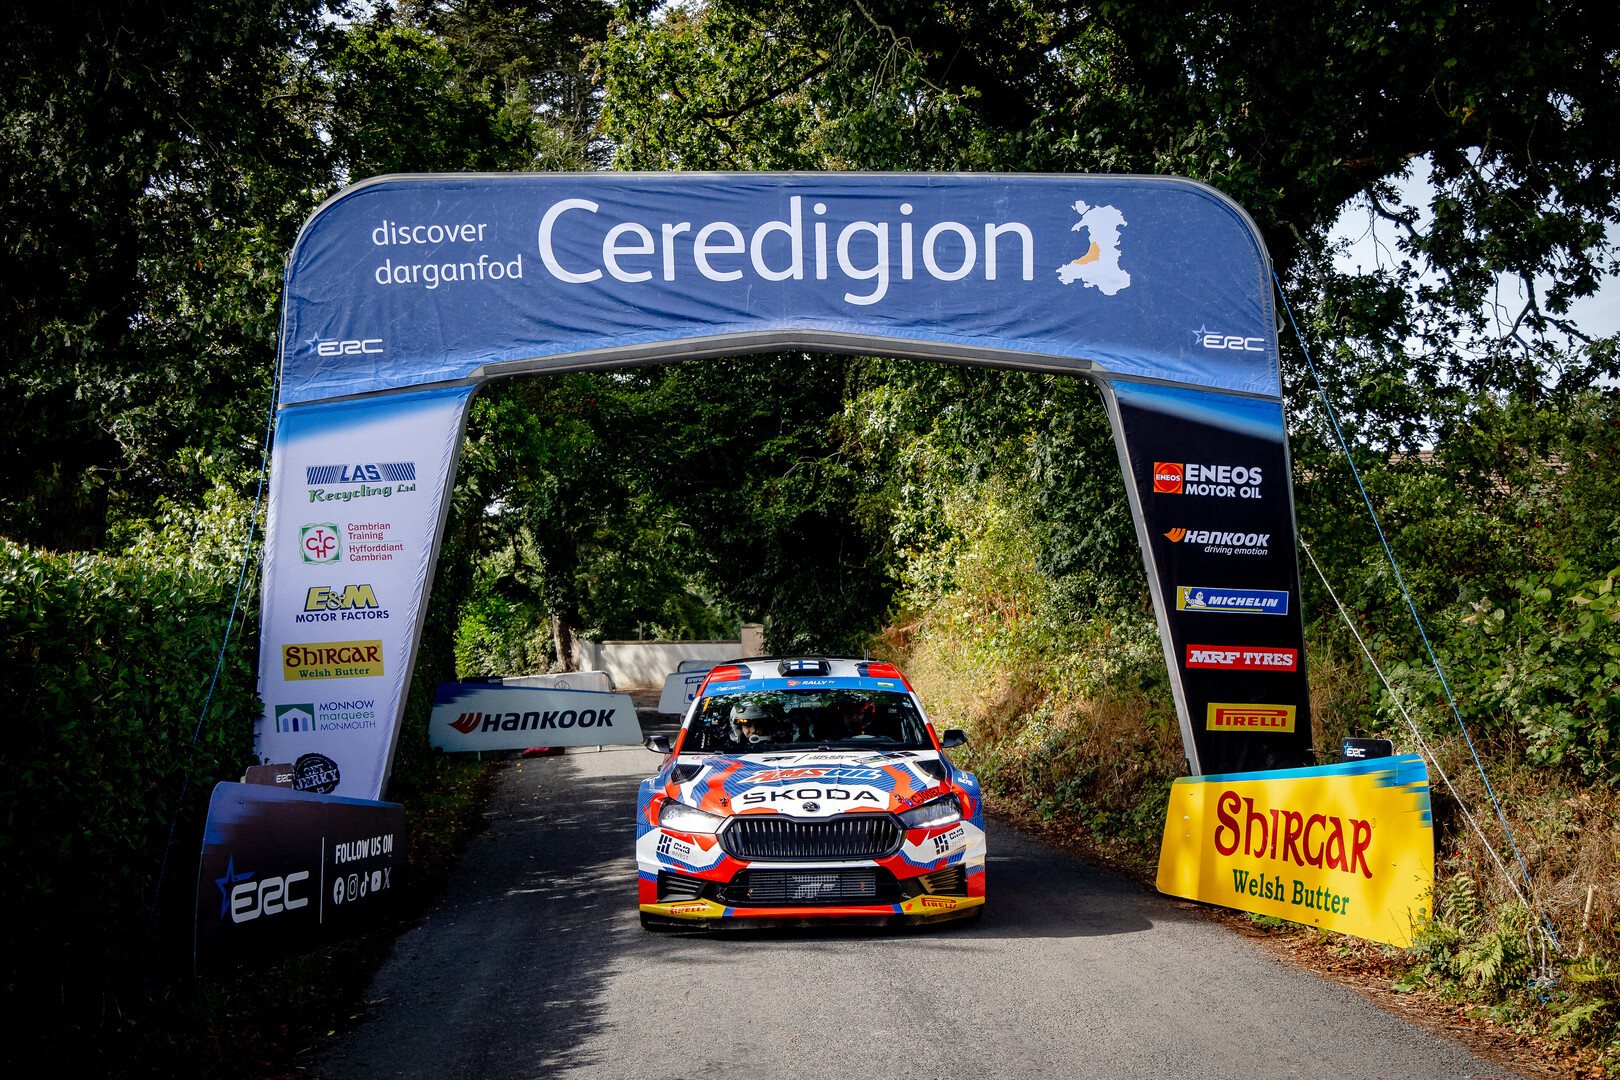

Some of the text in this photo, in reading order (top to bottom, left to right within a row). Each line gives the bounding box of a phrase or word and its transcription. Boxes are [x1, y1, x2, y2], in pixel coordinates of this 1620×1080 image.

[371, 220, 487, 246] discover
[538, 196, 1033, 305] Ceredigion
[375, 254, 523, 289] darganfod
[317, 338, 383, 357] ERC
[1203, 334, 1265, 352] ERC
[339, 464, 381, 482] LAS
[1155, 474, 1181, 482] ENEOS
[1185, 463, 1263, 486] ENEOS
[308, 483, 416, 503] Recycling Ltd
[1185, 483, 1262, 499] MOTOR OIL
[347, 523, 391, 531] Cambrian
[348, 532, 384, 541] Training
[349, 543, 403, 553] Hyfforddiant
[1204, 545, 1268, 556] driving emotion
[350, 553, 393, 562] Cambrian
[304, 584, 379, 612] E&M
[1208, 596, 1279, 608] MICHELIN
[295, 610, 389, 623] MOTOR FACTORS
[1189, 650, 1293, 666] MRF TYRES
[299, 667, 370, 678] Welsh Butter
[319, 700, 374, 711] MONNOW
[319, 711, 375, 722] marquees
[1215, 708, 1288, 727] PIRELLI
[320, 720, 376, 731] MONMOUTH
[1346, 748, 1366, 758] ERC
[295, 768, 338, 790] JERKY
[744, 768, 880, 782] AMSOIL
[335, 833, 393, 864] FOLLOW US ON
[230, 870, 309, 924] ERC
[1233, 868, 1349, 916] Welsh Butter
